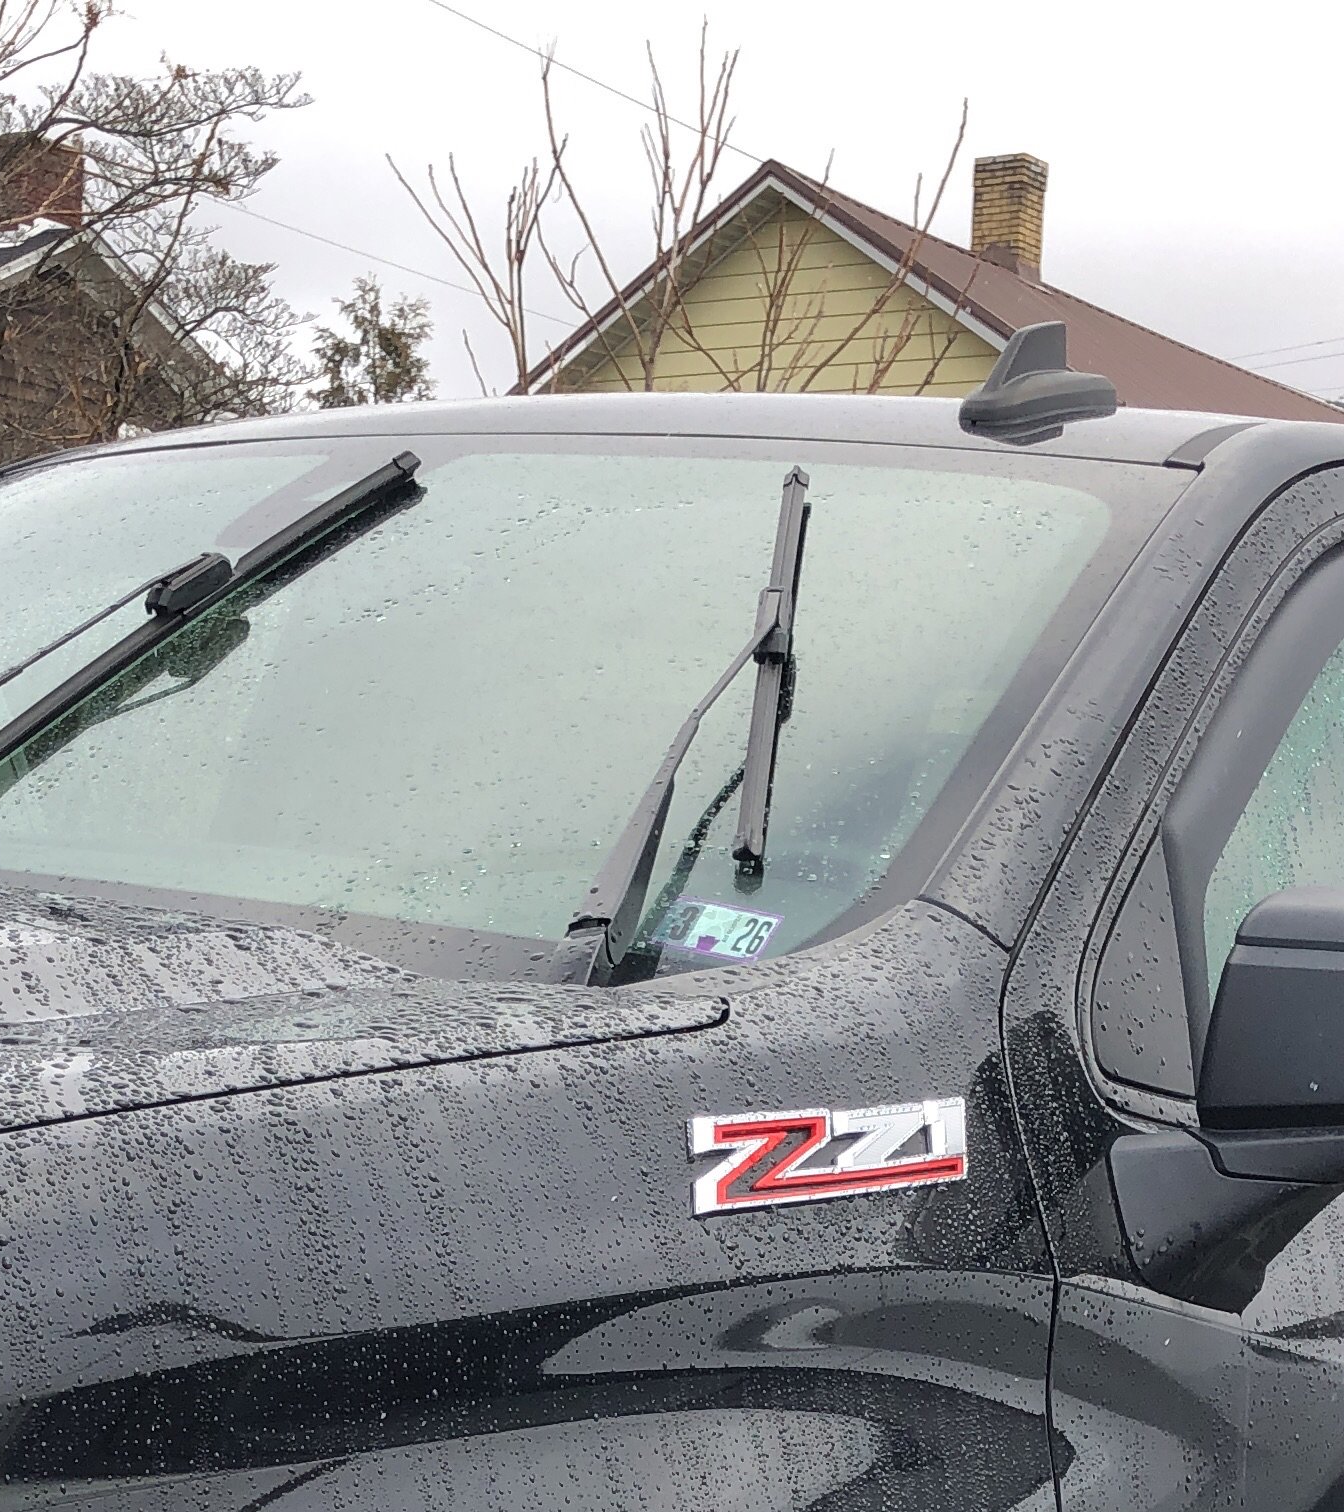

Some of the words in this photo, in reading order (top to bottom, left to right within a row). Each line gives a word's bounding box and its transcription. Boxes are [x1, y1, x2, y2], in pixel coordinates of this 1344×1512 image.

[669, 905, 700, 941] 3
[730, 917, 773, 955] 26
[687, 1097, 967, 1216] Z71
